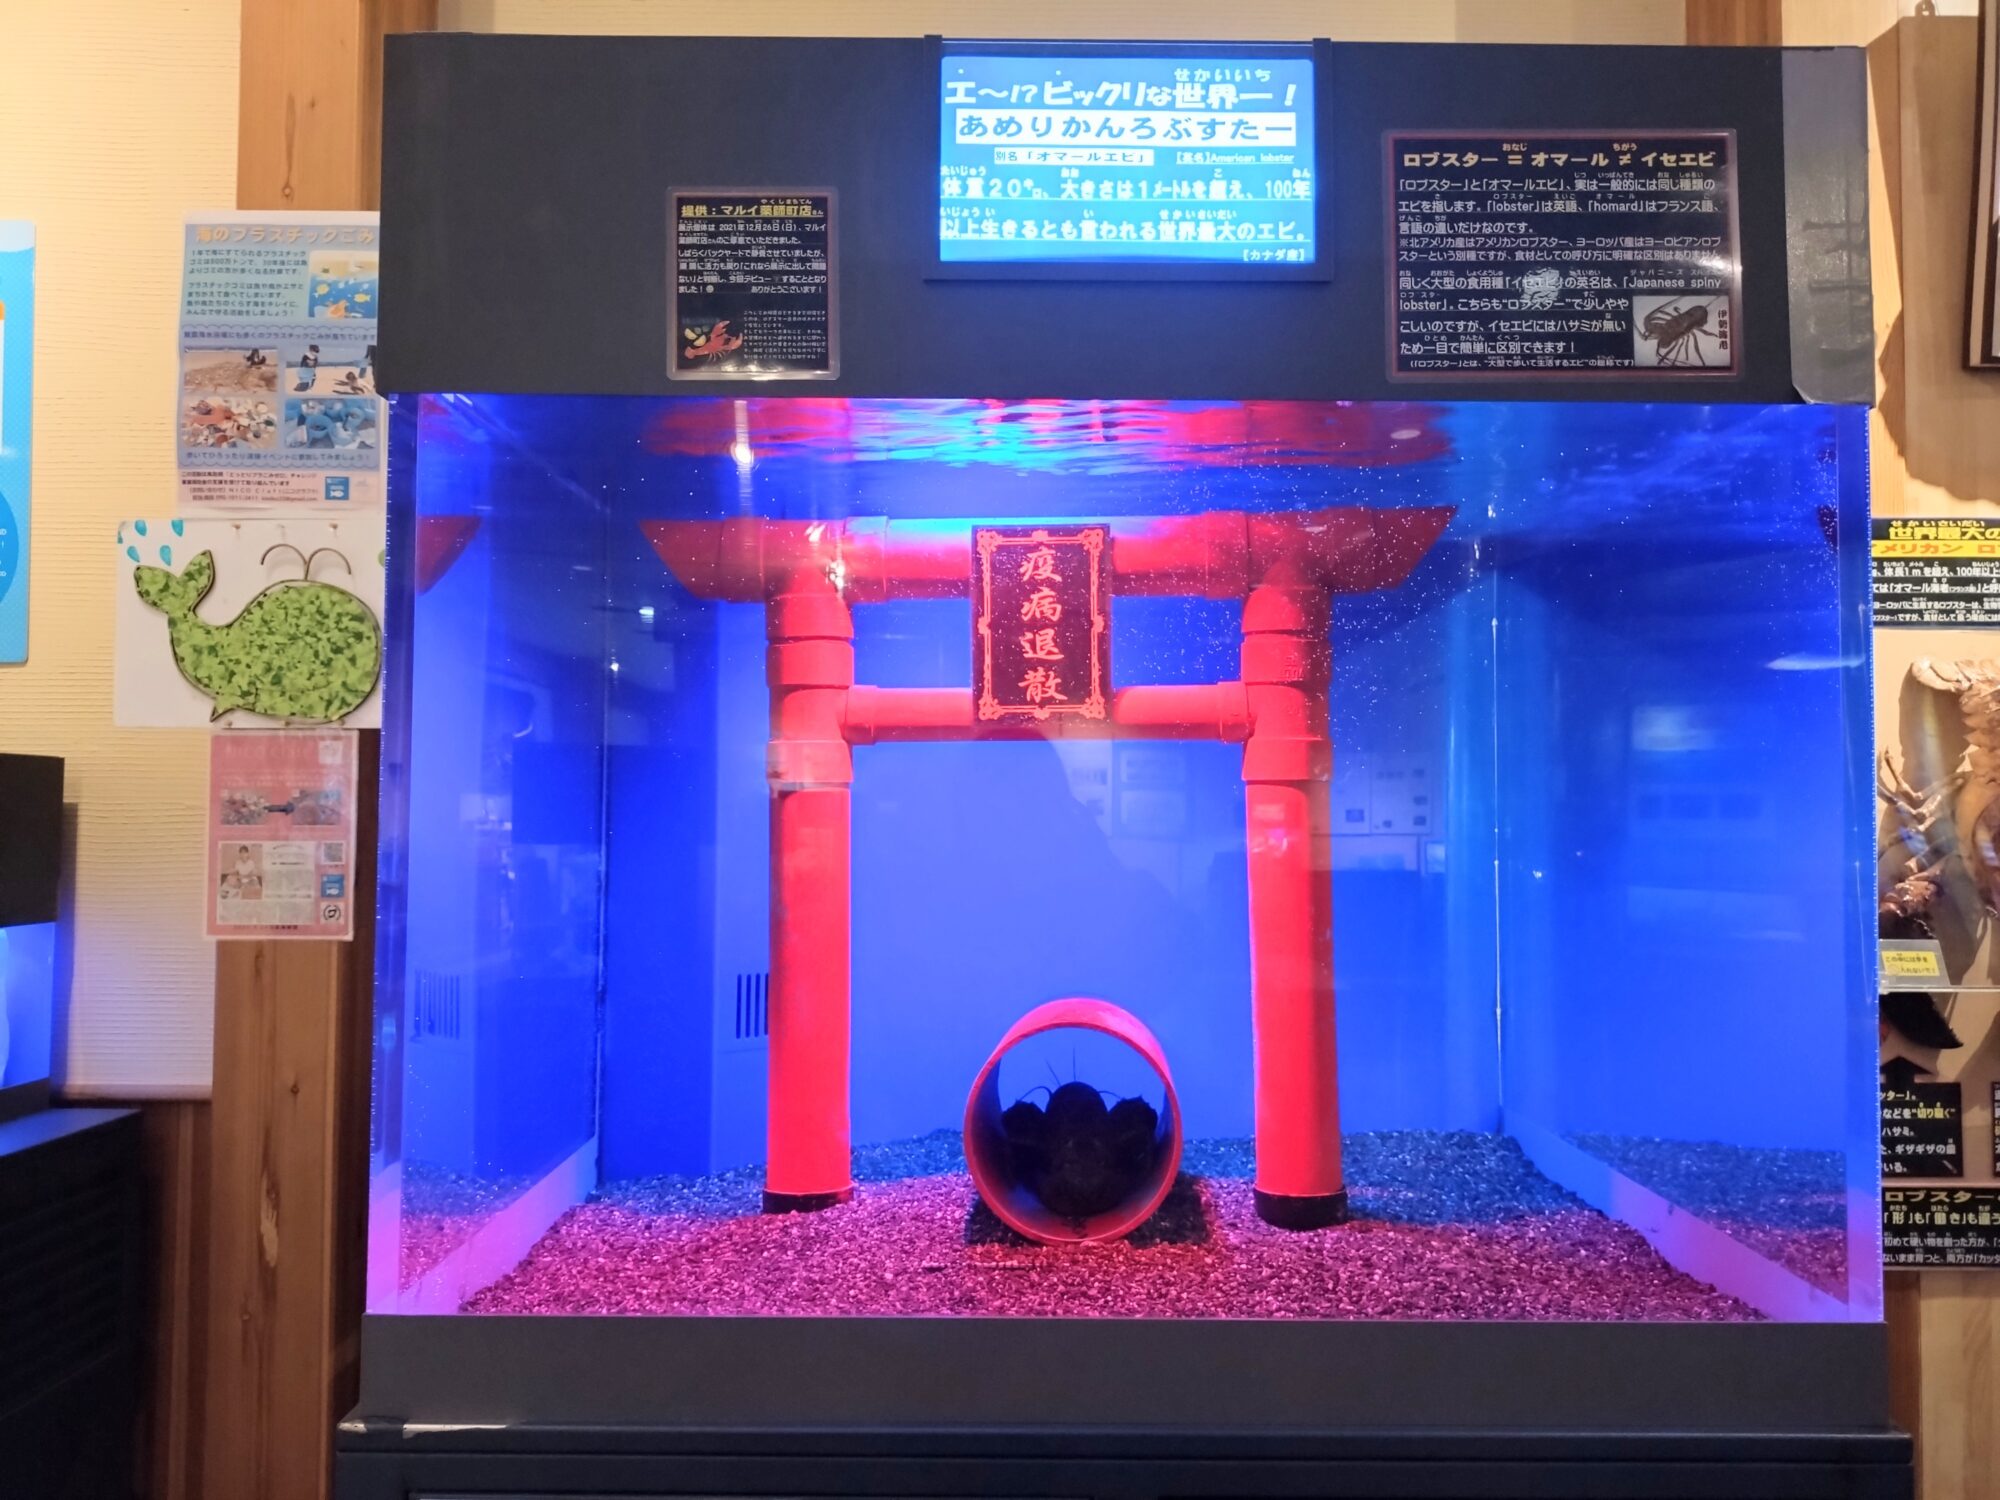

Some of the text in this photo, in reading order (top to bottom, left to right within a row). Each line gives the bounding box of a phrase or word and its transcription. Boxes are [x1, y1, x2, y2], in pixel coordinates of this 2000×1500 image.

[1174, 68, 1271, 82] せかいいち
[958, 115, 1293, 141] あめりかんろぶすたー
[995, 151, 1144, 163] 別名「オマールエビ」
[1403, 152, 1499, 167] ロブスター
[1531, 152, 1609, 167] オマール
[1641, 151, 1716, 167] イセエビ
[1399, 178, 1716, 192] 「ロブスター」と「オマールエビ」、実は一般的には同じ種類の
[1398, 199, 1720, 213] エビを指します。「lobster」は英語、「homard」はフランス語、
[1398, 221, 1534, 235] 言語の違いだけなのです。
[1690, 278, 1722, 289] spiny
[1400, 320, 1626, 333] こしいのですが、イセエビにはハサミが無い
[1400, 341, 1575, 355] ため一目で簡単に区別できます！
[1018, 546, 1068, 703] 疫病退散
